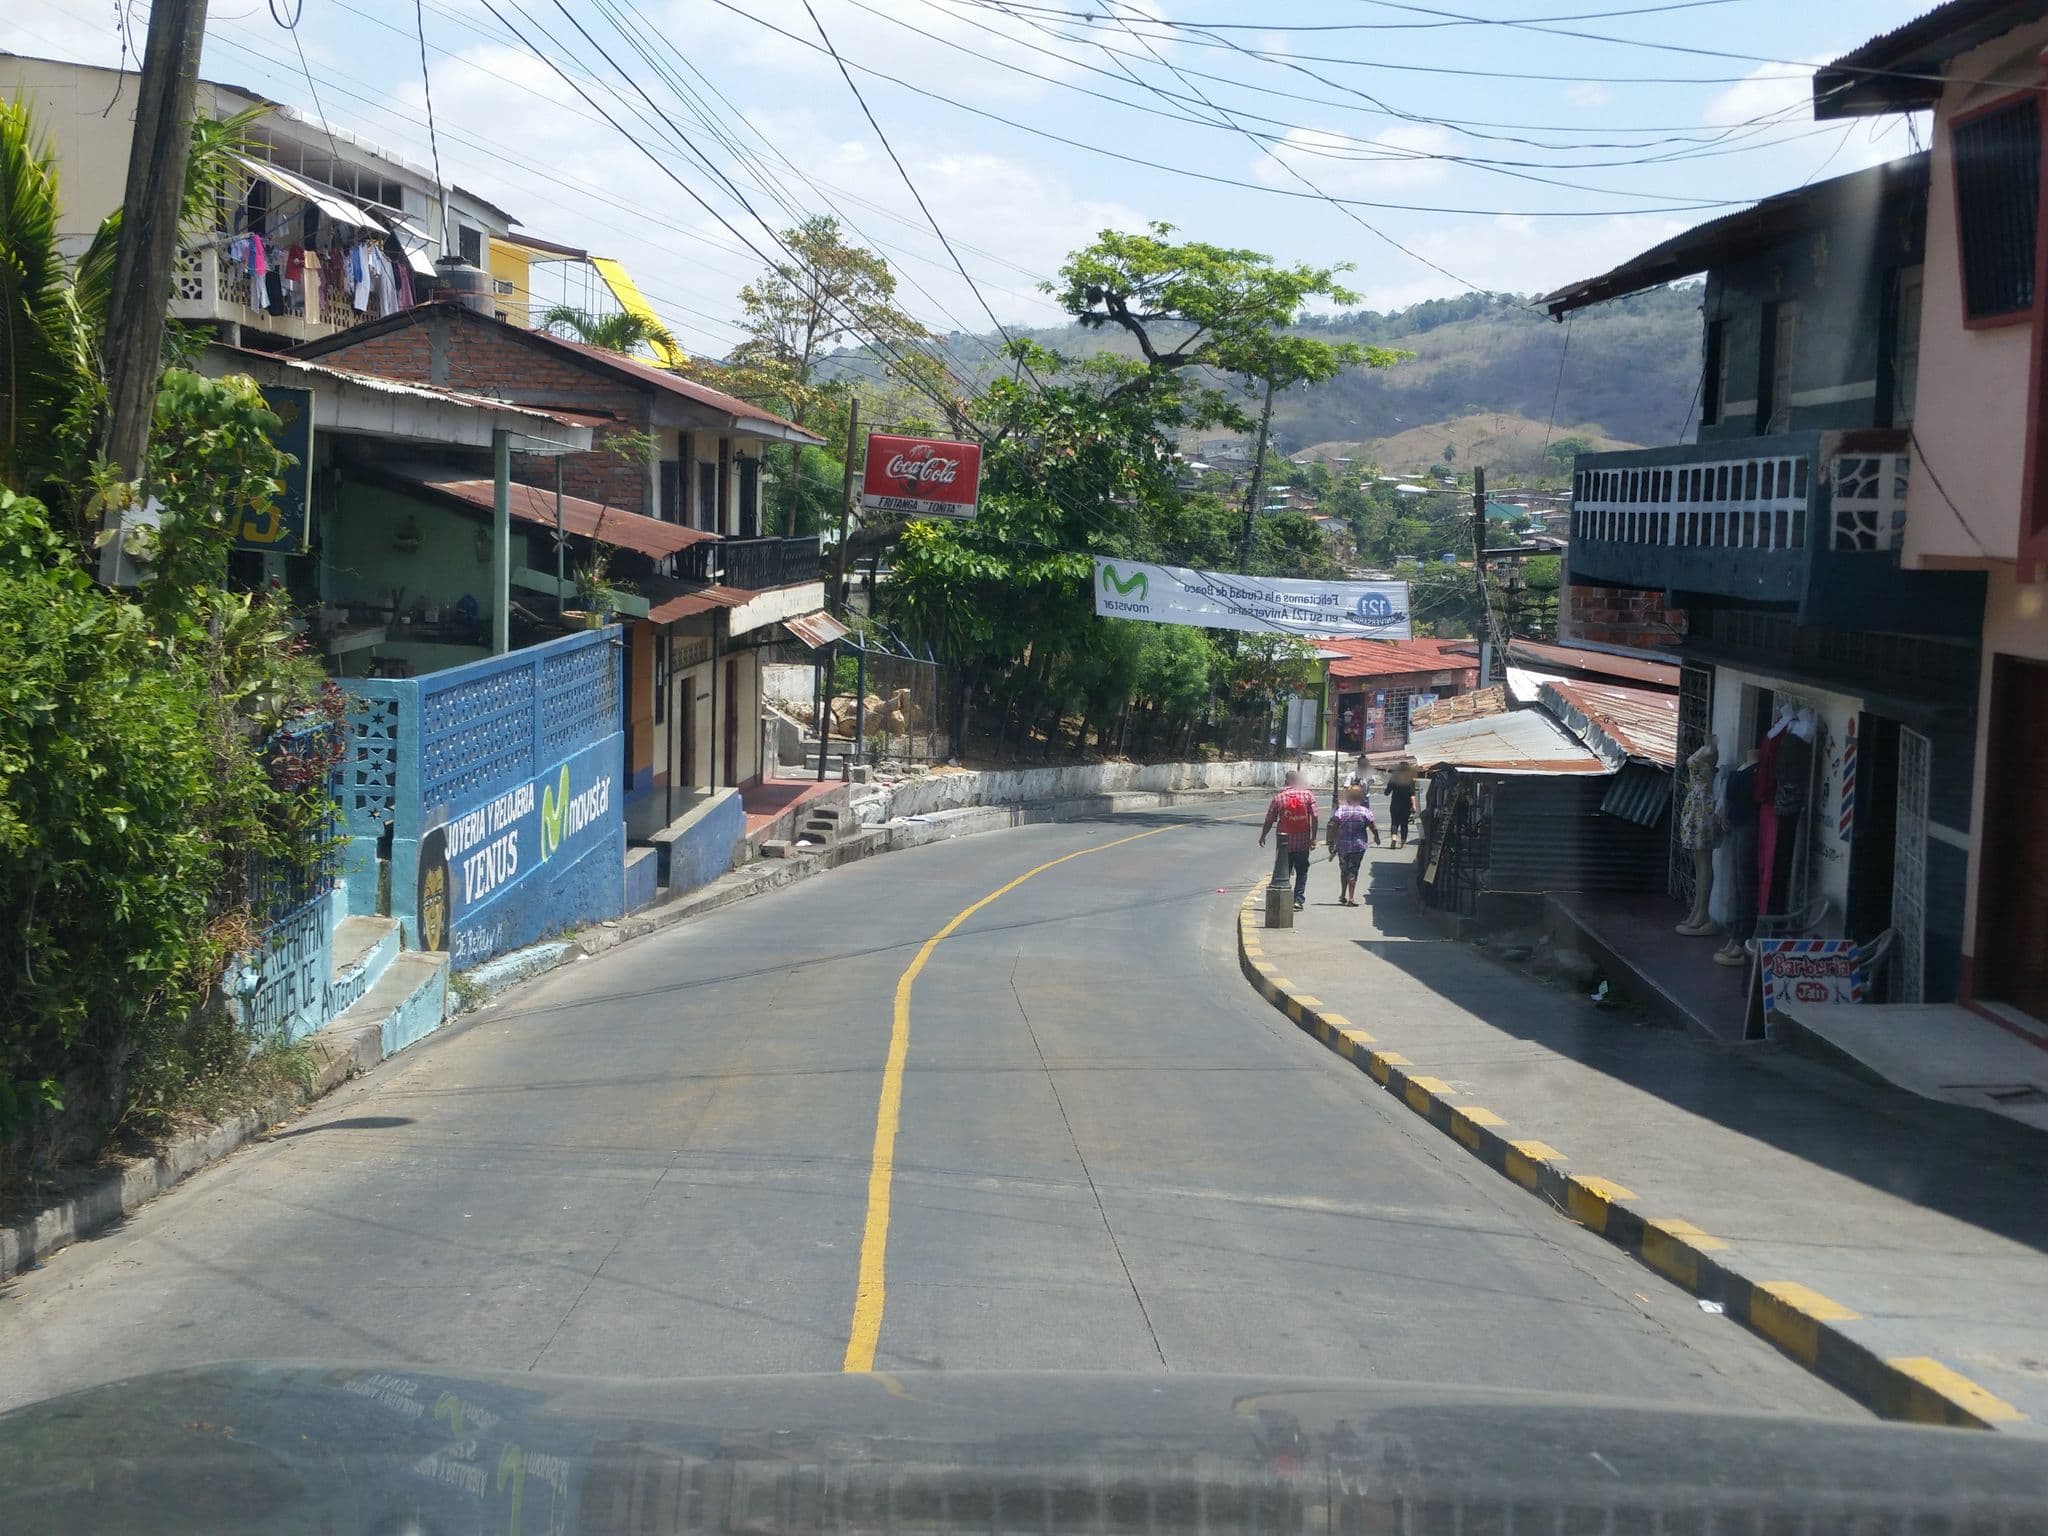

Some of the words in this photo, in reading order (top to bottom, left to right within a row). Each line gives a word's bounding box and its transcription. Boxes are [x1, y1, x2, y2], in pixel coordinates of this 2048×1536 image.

[878, 497, 918, 510] FRITANGA
[444, 808, 485, 861] JOYERIA
[486, 807, 494, 836] Y
[494, 782, 535, 832] RELOJERIA
[568, 776, 612, 836] movistar
[463, 829, 518, 905] VENUS
[302, 958, 316, 1009] DE
[1797, 983, 1825, 1000] Jair
